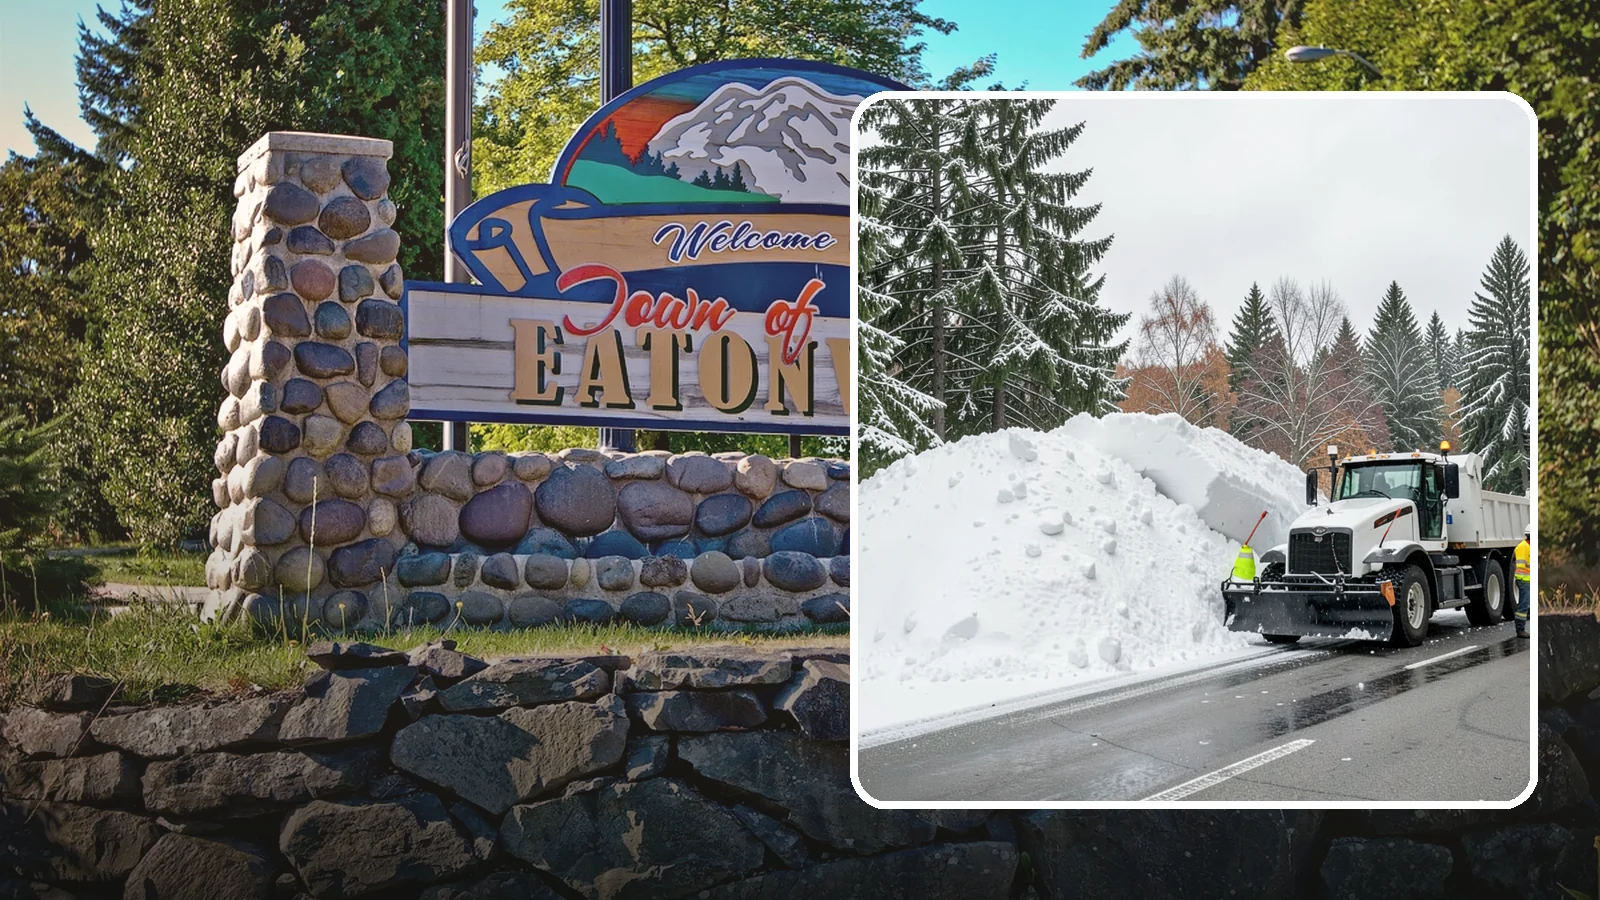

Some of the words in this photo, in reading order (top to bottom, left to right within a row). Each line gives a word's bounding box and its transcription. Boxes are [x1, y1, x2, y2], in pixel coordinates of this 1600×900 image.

[652, 220, 837, 264] Welcome
[556, 262, 737, 337] Town
[764, 278, 826, 366] of
